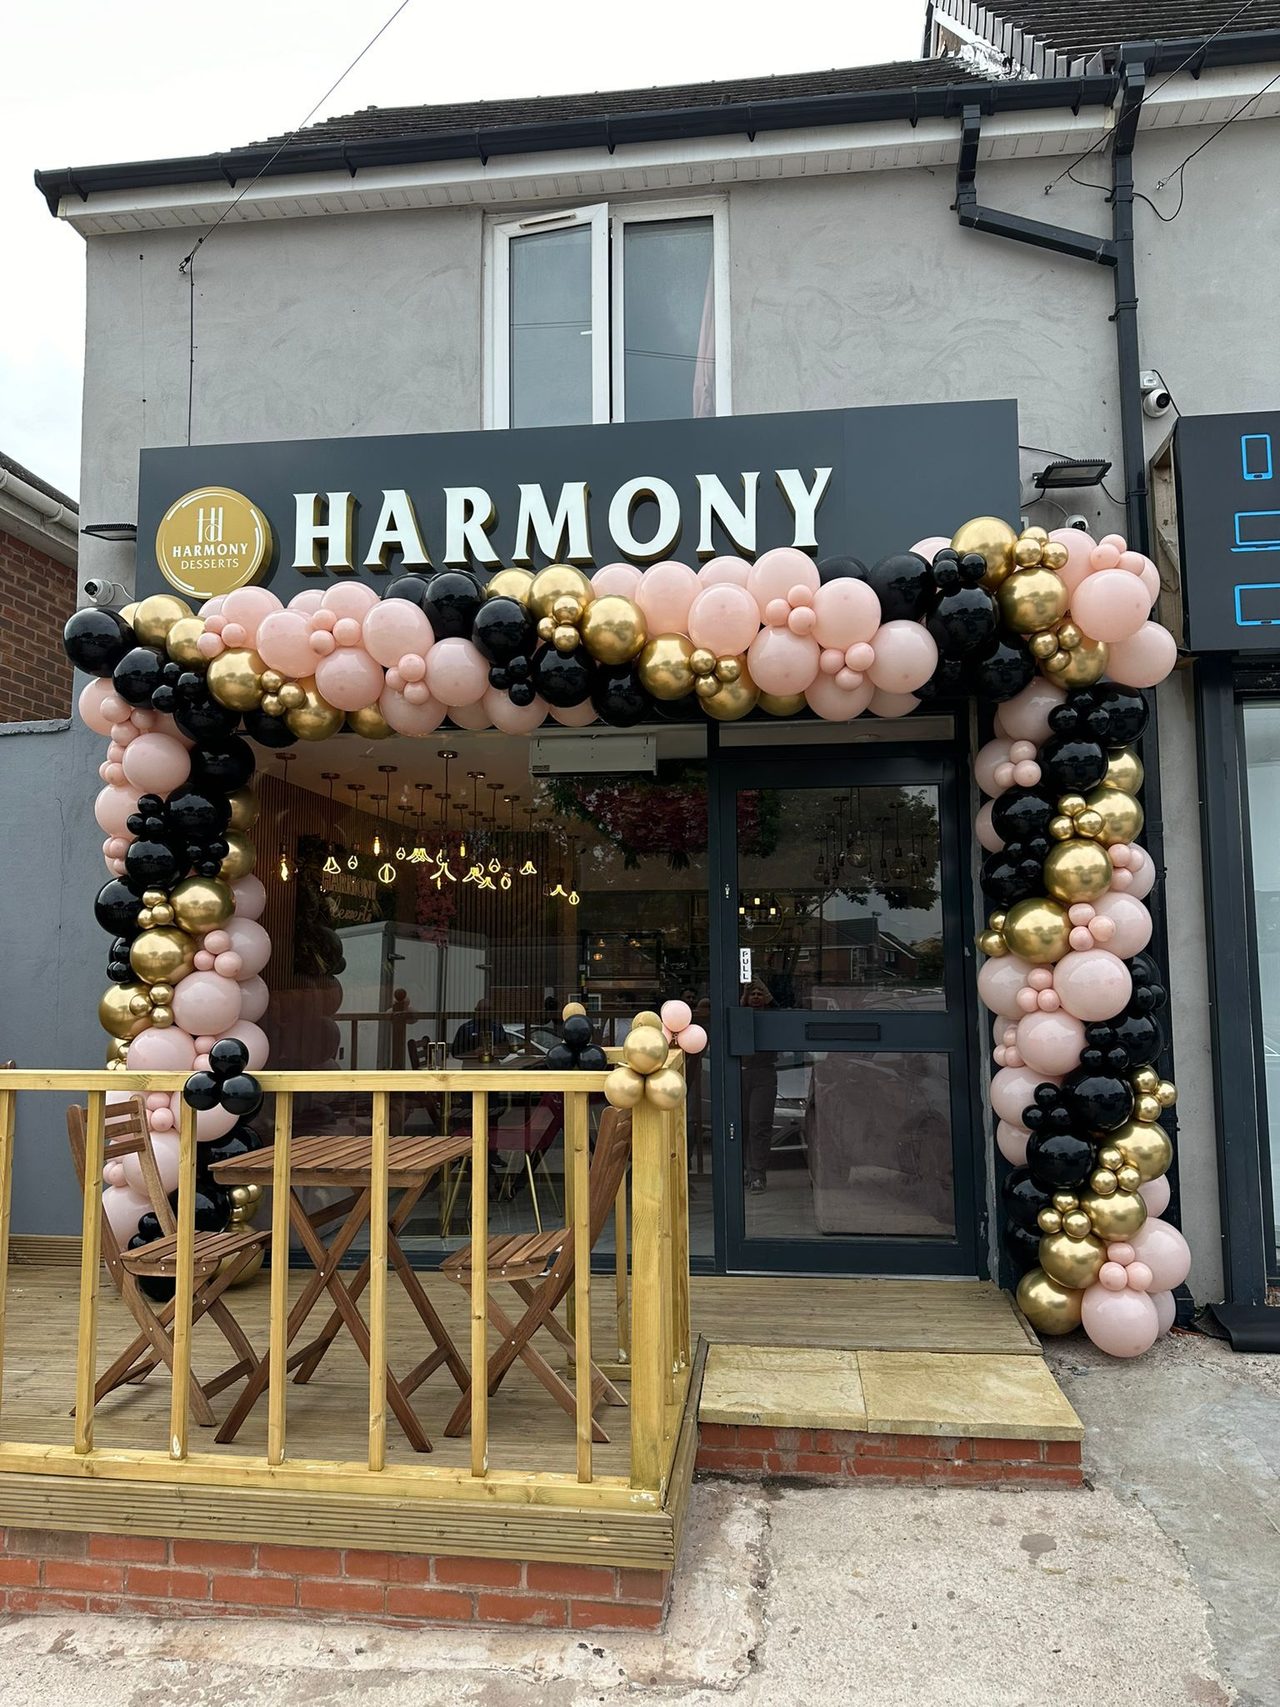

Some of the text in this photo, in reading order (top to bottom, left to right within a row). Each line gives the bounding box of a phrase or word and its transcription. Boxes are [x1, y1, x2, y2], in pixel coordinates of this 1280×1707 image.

[291, 466, 833, 571] HARMONY
[172, 543, 249, 558] HARMONY
[181, 558, 240, 570] DESSERTS
